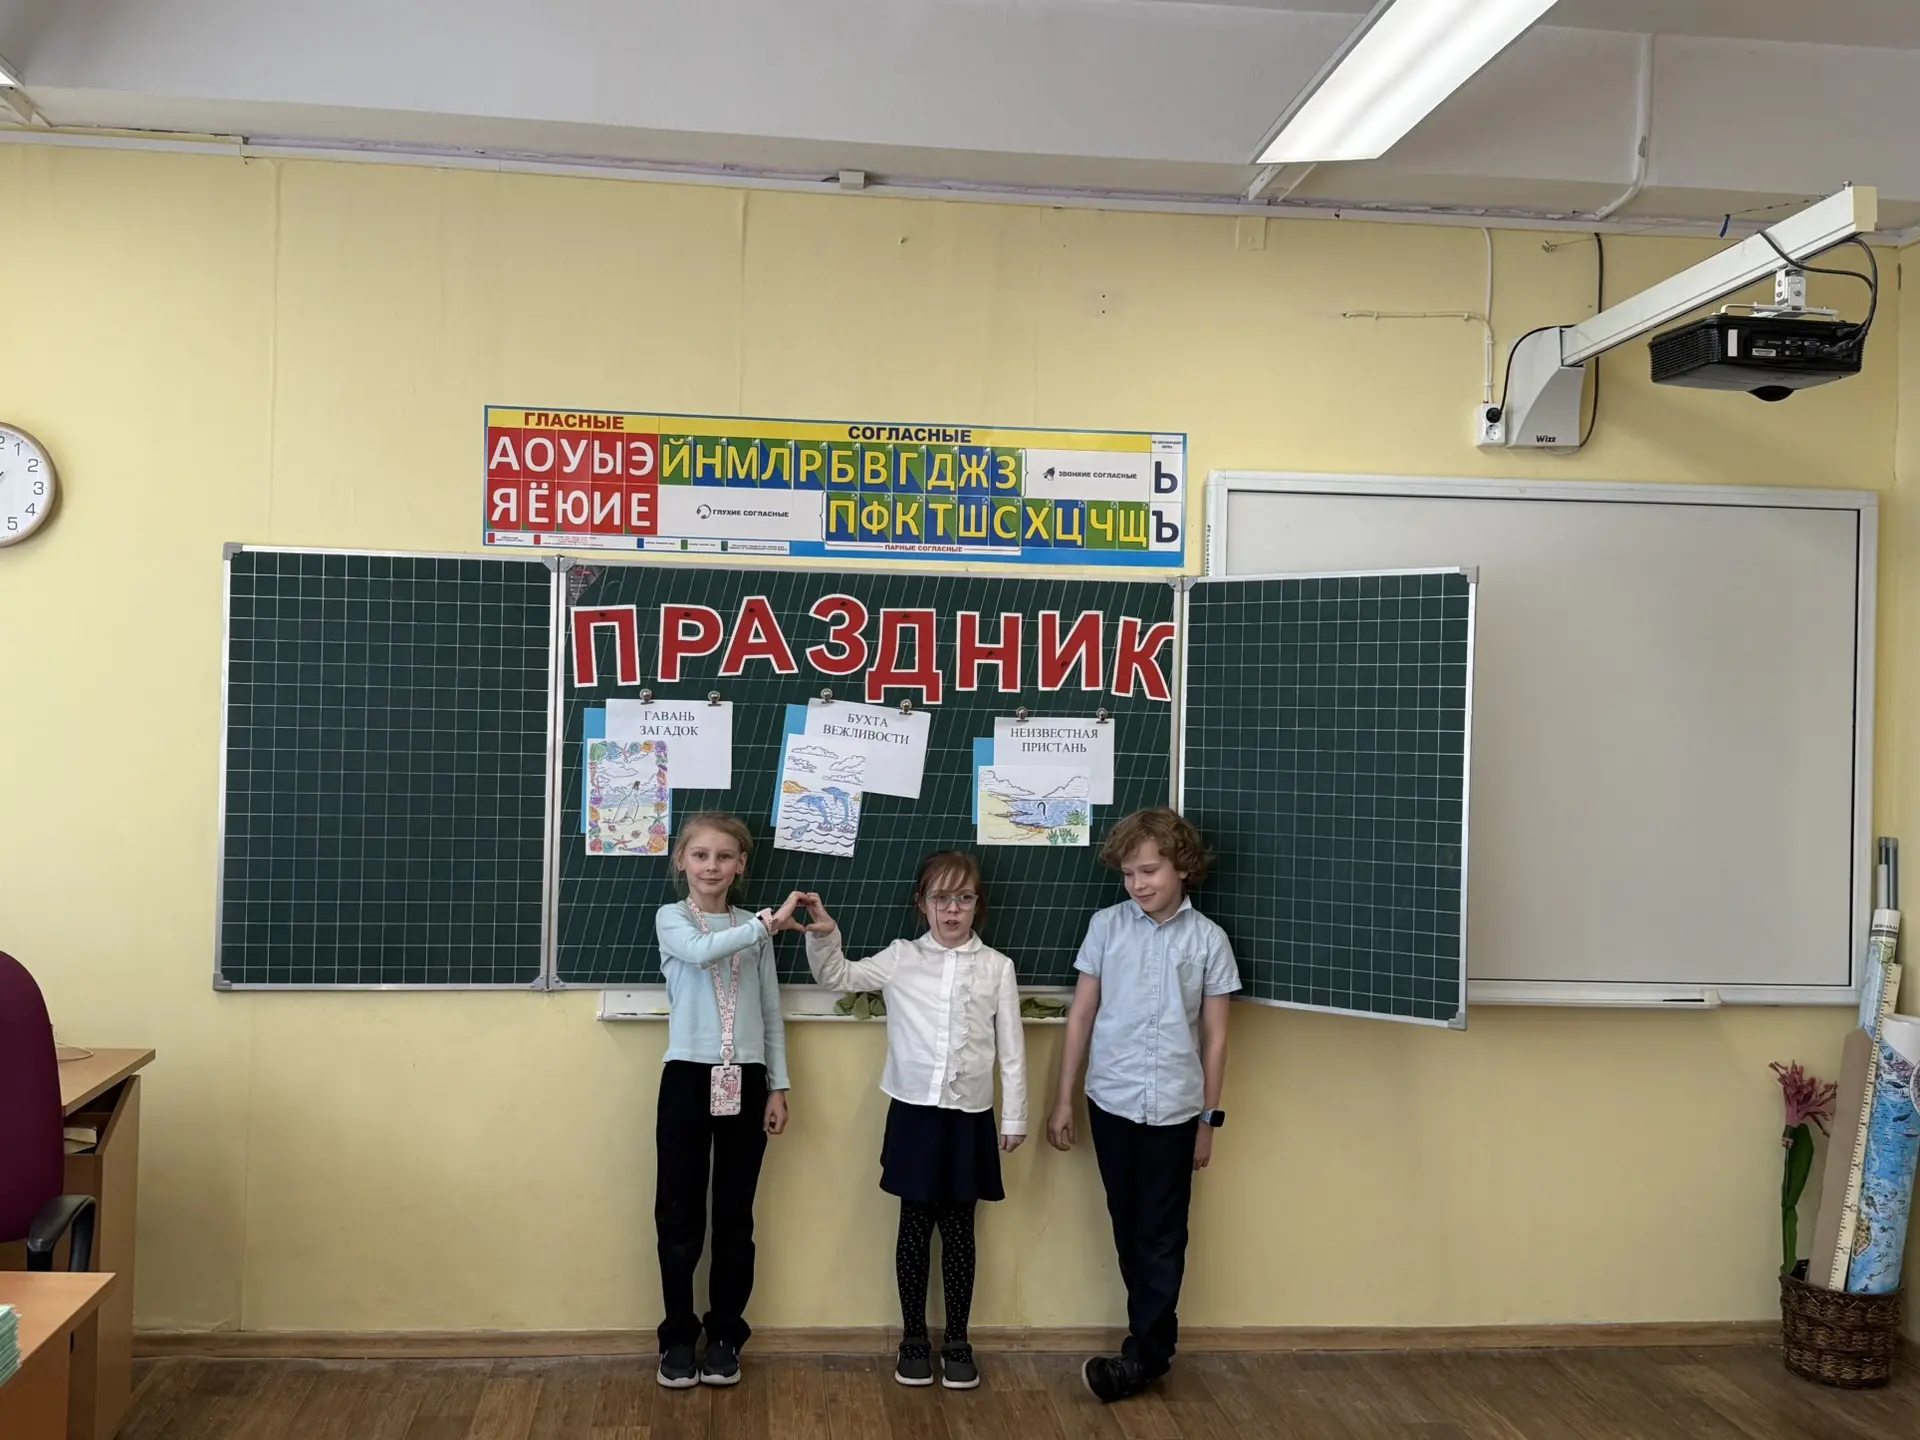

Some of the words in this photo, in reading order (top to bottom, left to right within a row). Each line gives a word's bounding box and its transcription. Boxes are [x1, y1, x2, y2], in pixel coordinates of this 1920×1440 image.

[524, 411, 625, 430] ГЛАСНЫЕ
[848, 425, 973, 444] СОГЛАСНЫЕ
[1535, 434, 1557, 443] Wizz
[27, 458, 39, 472] 2
[1092, 472, 1138, 480] СОГЛАСНЫЕ
[33, 481, 44, 495] 3
[25, 502, 36, 516] 4
[743, 510, 790, 518] СОГЛАСНЫЕ
[7, 516, 18, 531] 5
[570, 593, 1178, 704] ПРАЗДНИК
[643, 710, 696, 722] ГАВАНЬ
[847, 713, 889, 728] БУХТА
[639, 725, 699, 738] ЗАГАДОК
[822, 723, 910, 745] ВЕЖЛИВОСТИ
[1010, 727, 1099, 739] НЕИЗВЕСТНАЯ
[1021, 742, 1087, 753] ПРИСТАНЬ
